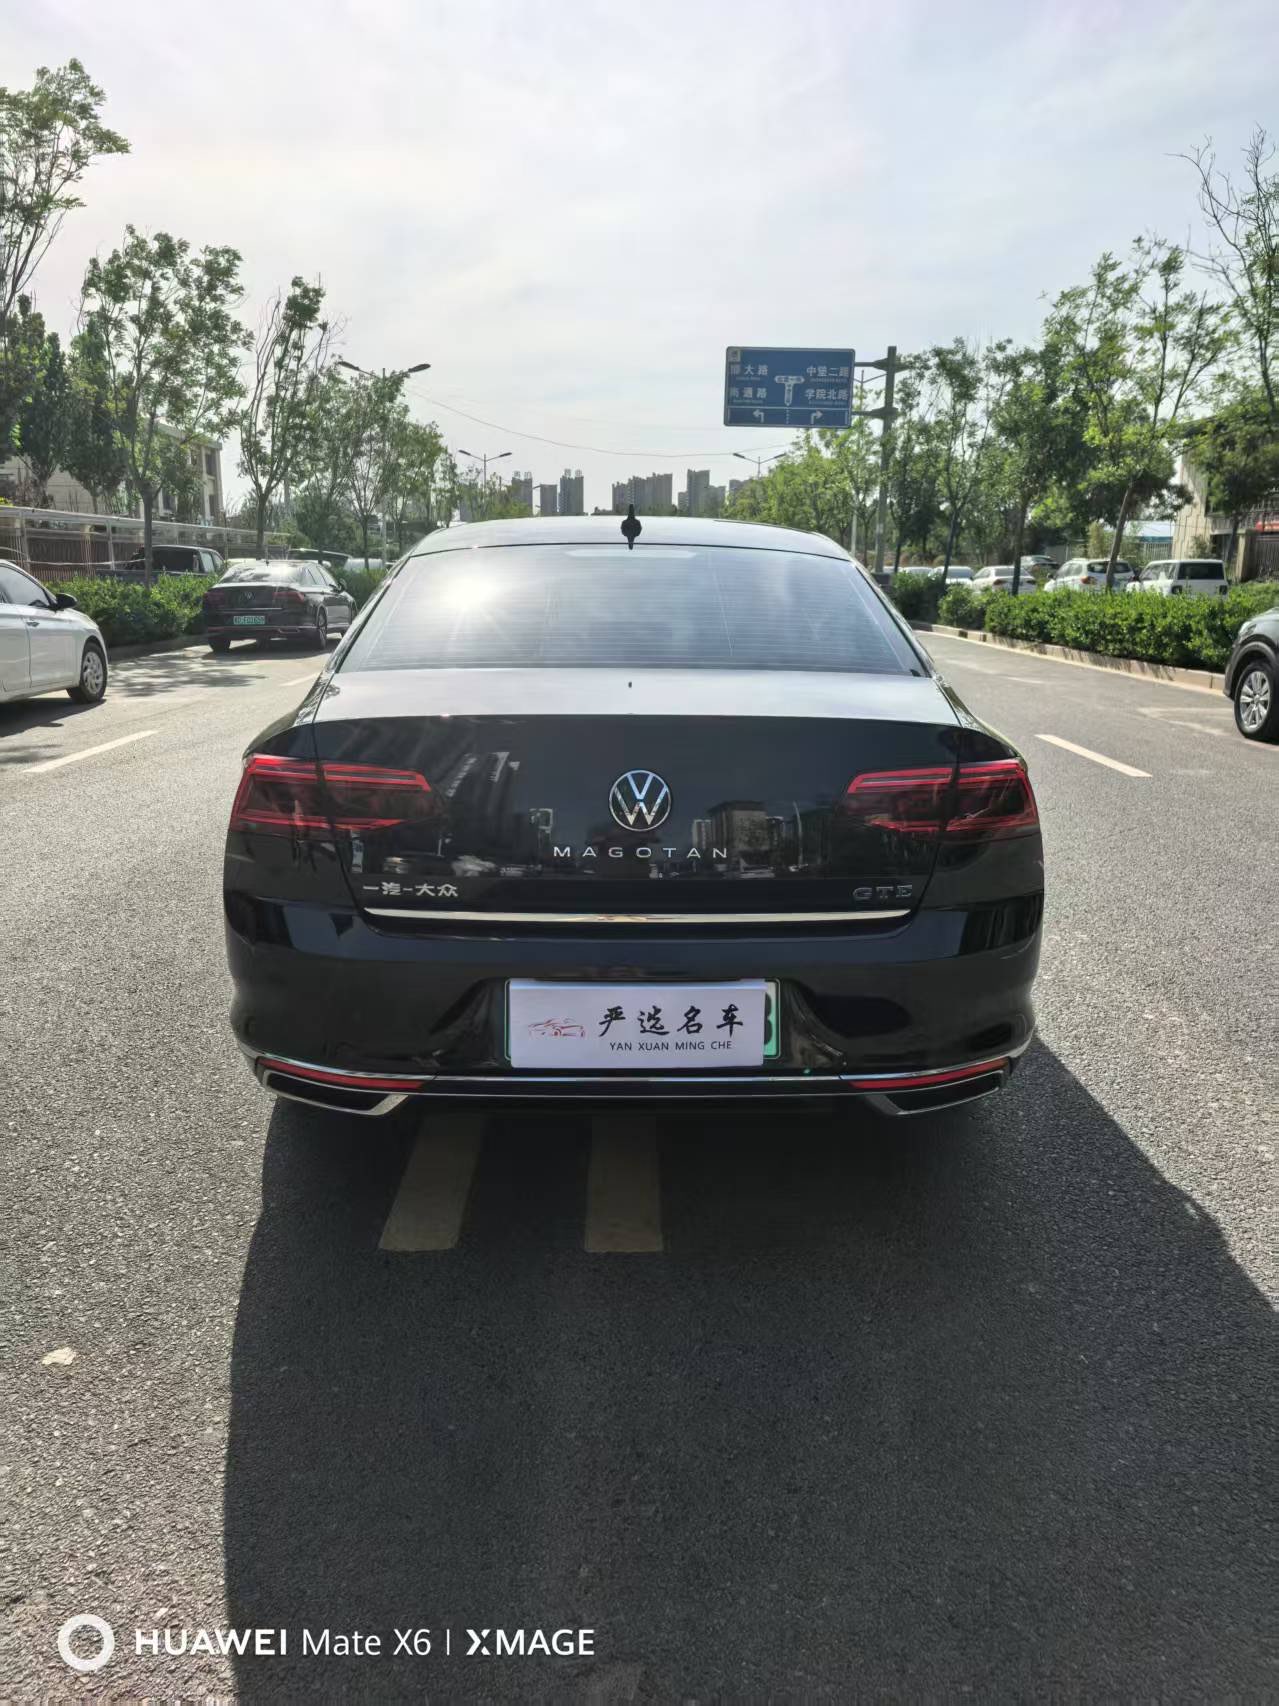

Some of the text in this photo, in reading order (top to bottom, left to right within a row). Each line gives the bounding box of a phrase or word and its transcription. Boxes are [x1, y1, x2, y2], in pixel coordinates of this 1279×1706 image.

[553, 846, 727, 858] MAGOTAN
[363, 881, 458, 897] 一汽-大众
[853, 884, 913, 900] GTE
[597, 1003, 744, 1038] 严选名车
[609, 1040, 732, 1051] YAN XUAN MING CHE
